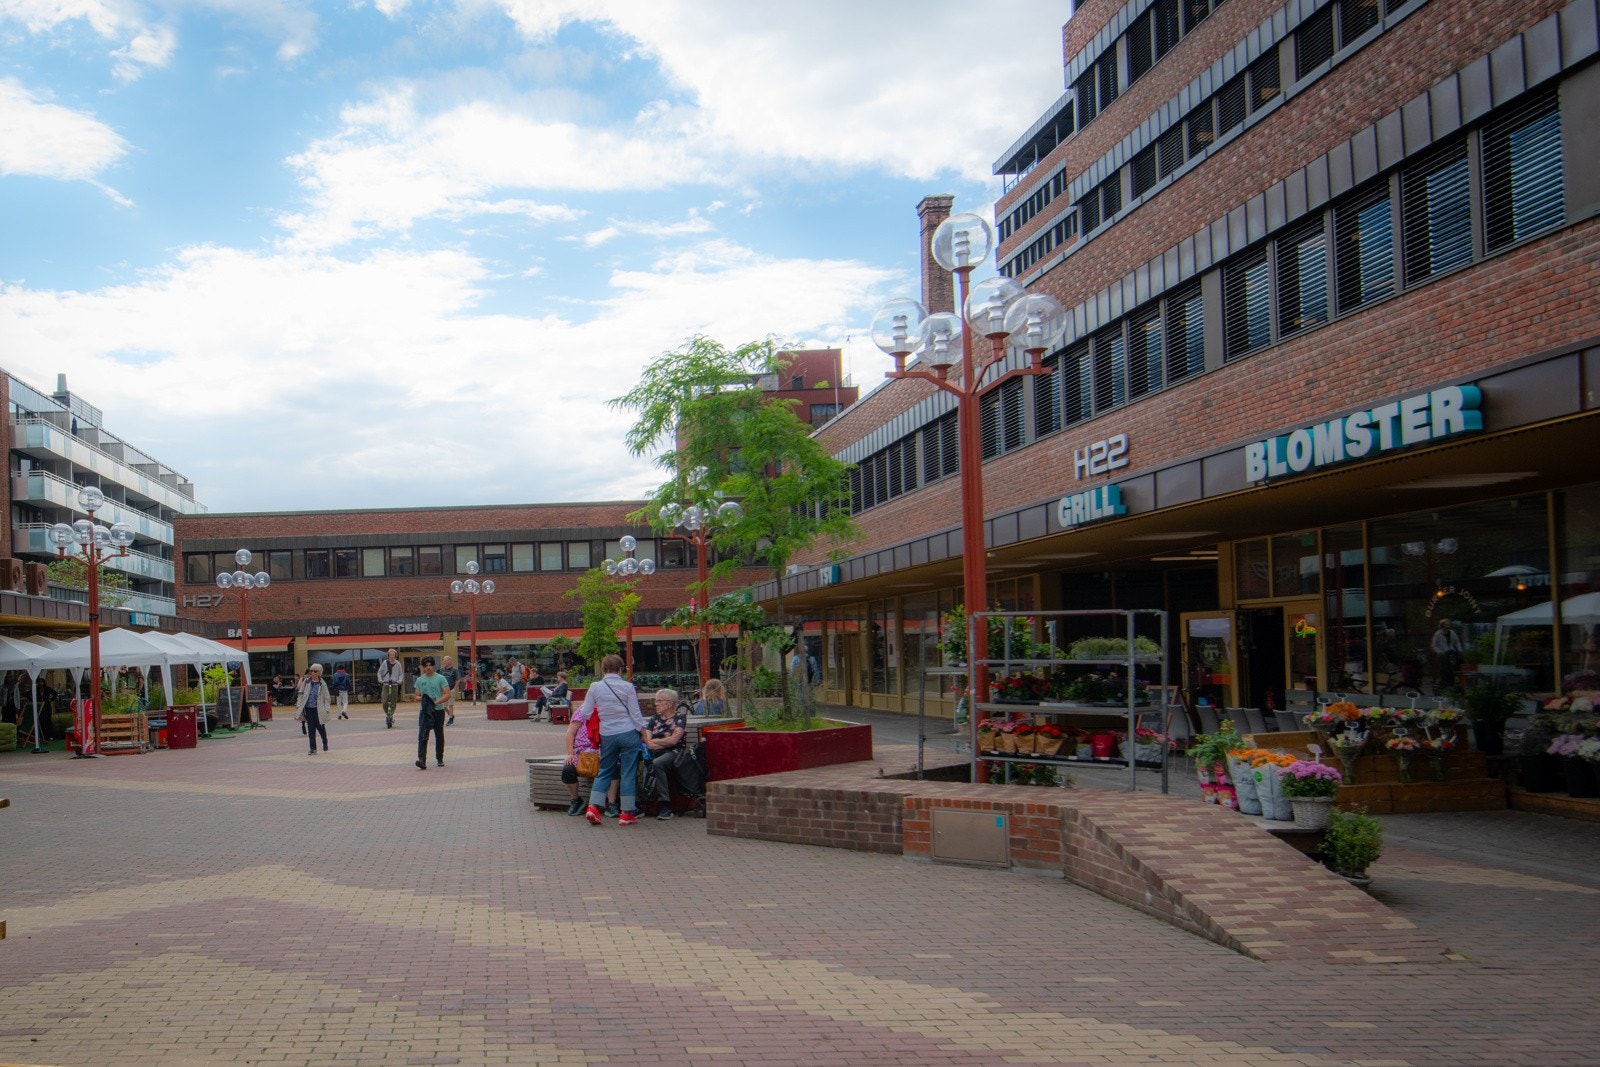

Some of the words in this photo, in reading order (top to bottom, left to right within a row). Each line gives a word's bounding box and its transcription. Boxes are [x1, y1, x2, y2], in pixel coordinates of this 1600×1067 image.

[1245, 385, 1475, 483] BLOMSTER
[1073, 433, 1130, 480] H22
[1058, 484, 1120, 528] GRILL
[182, 593, 225, 608] H27
[1425, 585, 1456, 618] BURER
[227, 628, 253, 638] BAR
[315, 625, 341, 635] MAT
[388, 622, 429, 633] SCENE
